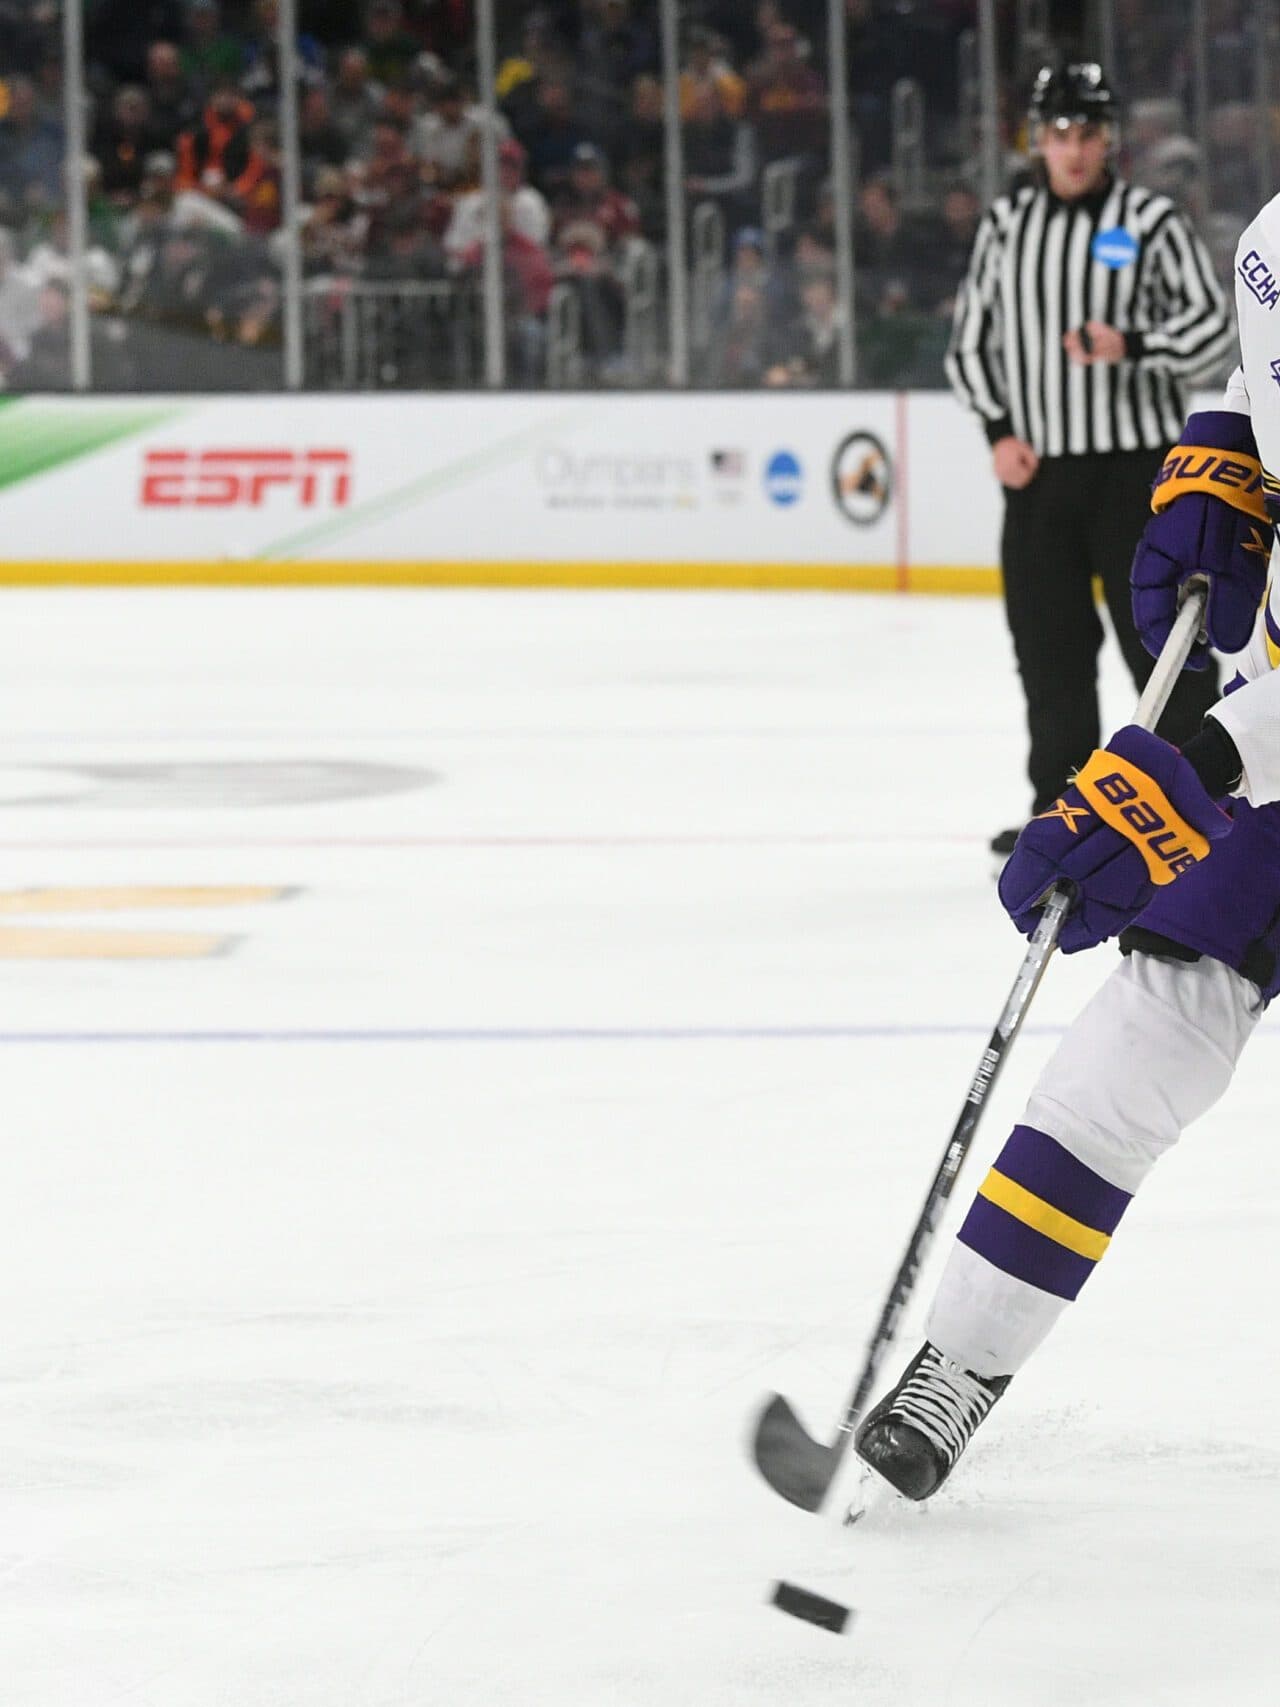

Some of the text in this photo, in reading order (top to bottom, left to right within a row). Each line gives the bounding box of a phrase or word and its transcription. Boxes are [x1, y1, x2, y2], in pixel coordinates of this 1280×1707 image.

[1239, 250, 1280, 310] CCHA
[142, 450, 349, 506] ESPN
[1094, 773, 1198, 876] BAUE
